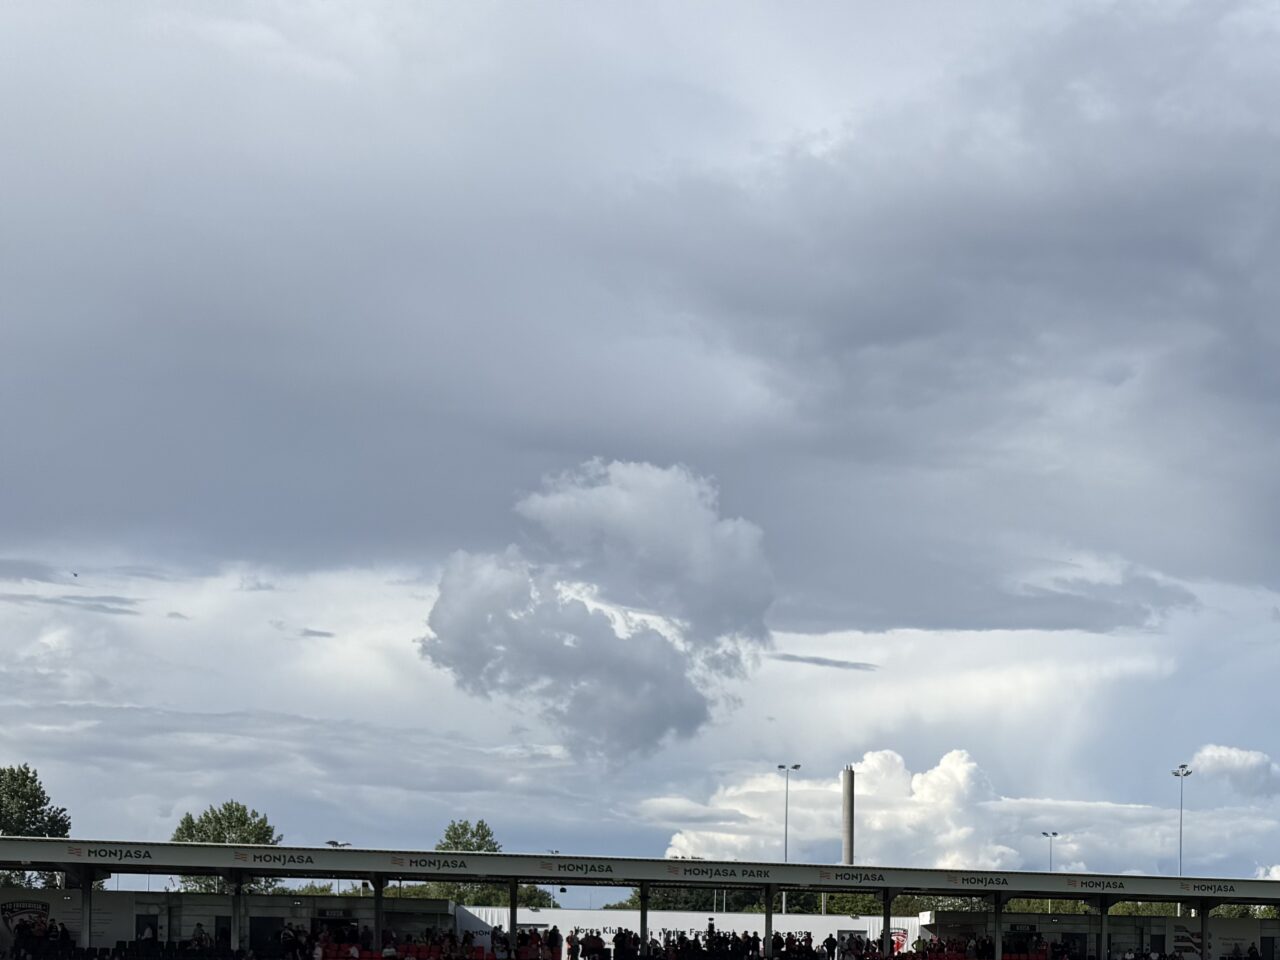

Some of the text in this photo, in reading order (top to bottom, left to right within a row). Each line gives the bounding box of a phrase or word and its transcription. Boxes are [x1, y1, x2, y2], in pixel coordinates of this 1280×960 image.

[87, 848, 152, 861] MONJASA
[253, 854, 314, 866] MONJASA
[409, 859, 467, 870] MONJASA
[558, 863, 613, 874] MONJASA
[683, 867, 770, 878] MONJASA PARK
[835, 872, 885, 883] MONJASA
[961, 877, 1009, 887] MONJASA
[1080, 880, 1125, 890] MONJASA
[1193, 884, 1235, 894] MONJASA
